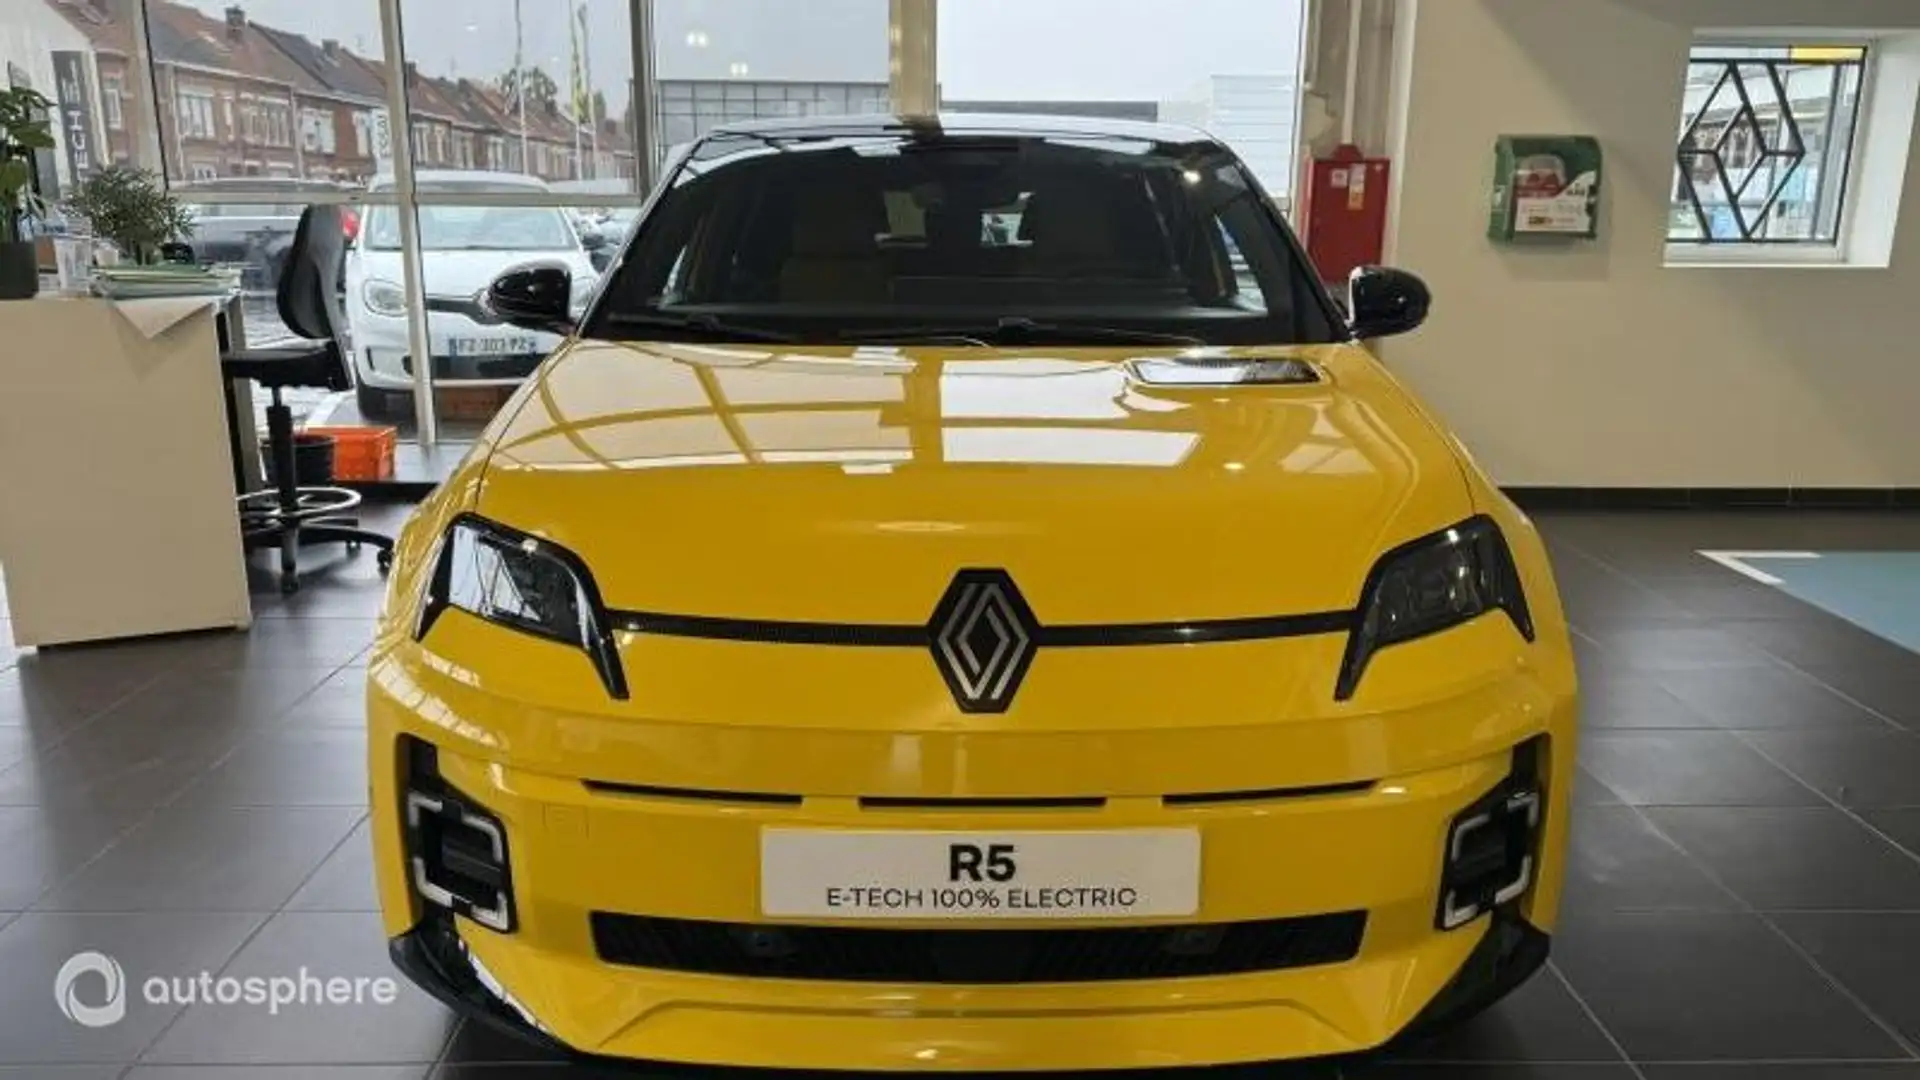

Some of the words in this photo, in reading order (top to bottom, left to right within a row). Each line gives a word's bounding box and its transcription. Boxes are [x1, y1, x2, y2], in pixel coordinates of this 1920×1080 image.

[949, 844, 1017, 882] R5
[825, 887, 924, 909] E-TECH
[931, 888, 1001, 909] 100%
[1007, 887, 1138, 909] ELECTRIC
